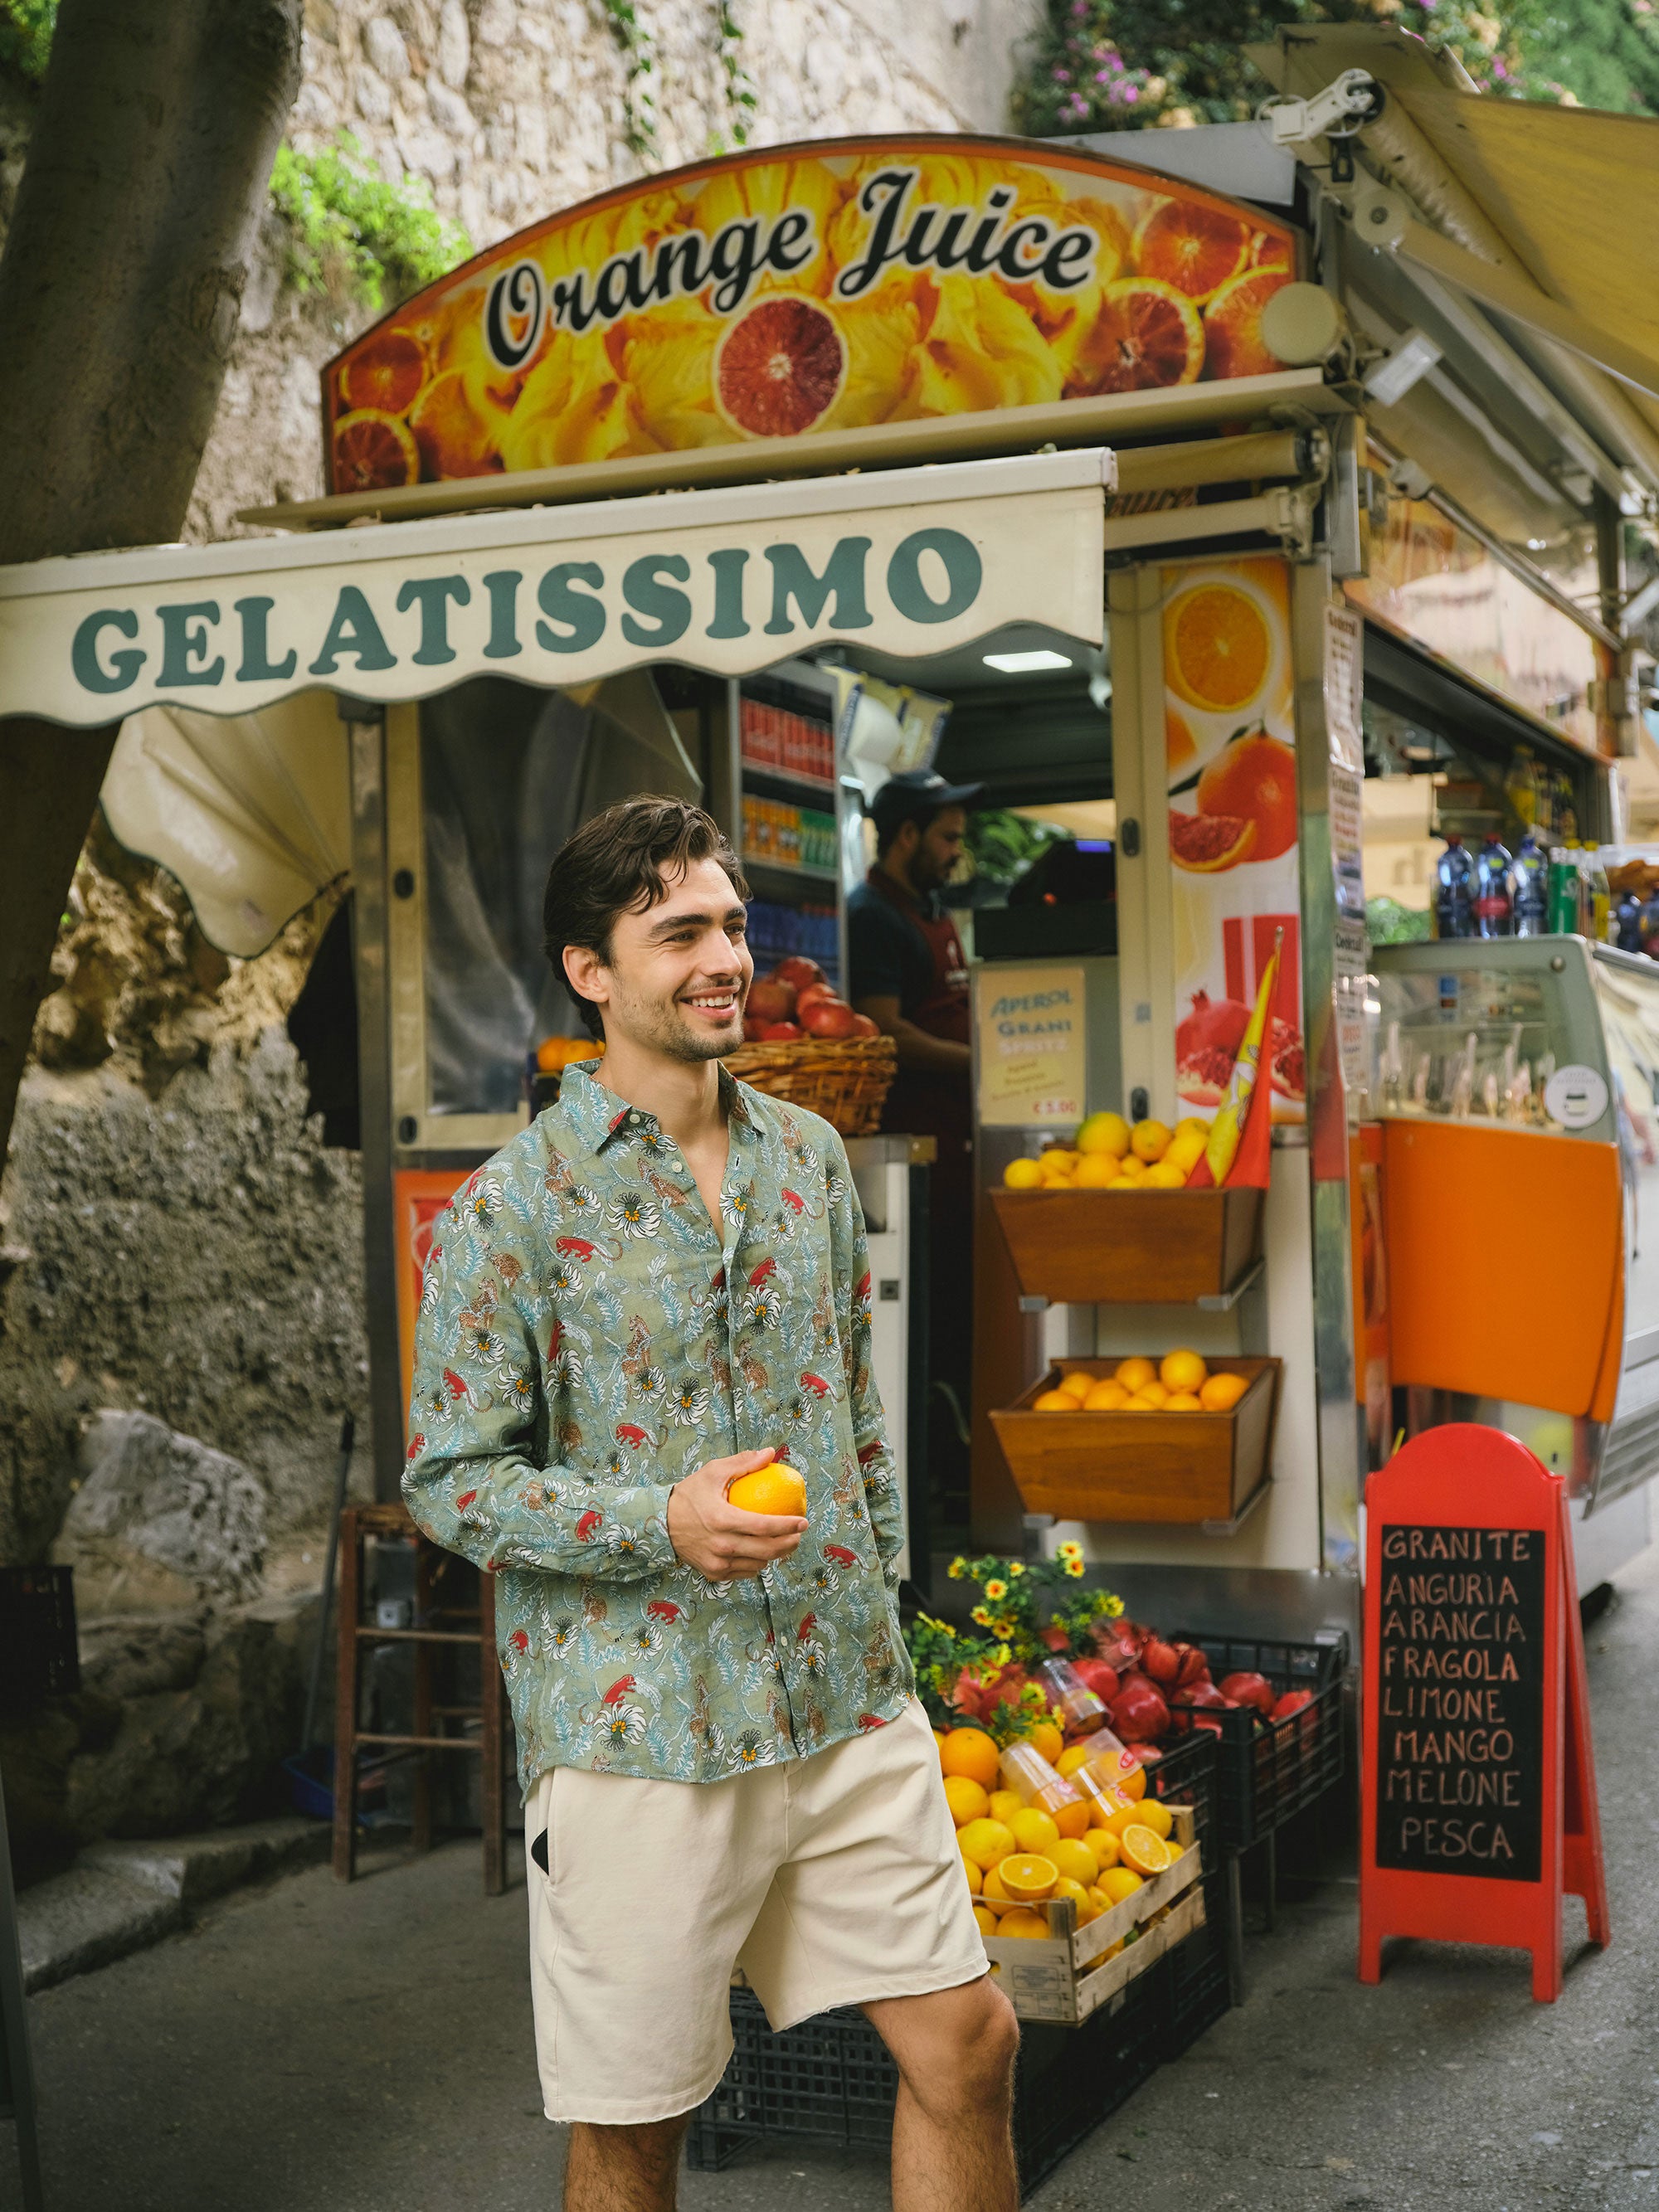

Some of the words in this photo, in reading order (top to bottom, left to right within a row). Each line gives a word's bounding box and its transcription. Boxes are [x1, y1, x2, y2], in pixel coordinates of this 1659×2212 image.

[486, 211, 815, 367] Orange
[838, 171, 1094, 289] Juice
[71, 527, 985, 695] GELATISSIMO
[1383, 1529, 1531, 1562] GRANITE
[1384, 1573, 1520, 1607] ANGURIA
[1383, 1607, 1527, 1643] ARANCIA
[1384, 1645, 1520, 1682] FRAGOLA
[1384, 1686, 1506, 1723] LIMONE
[1394, 1728, 1515, 1764] MANGO
[1385, 1767, 1522, 1807] MELONE
[1401, 1816, 1515, 1860] PESCA
